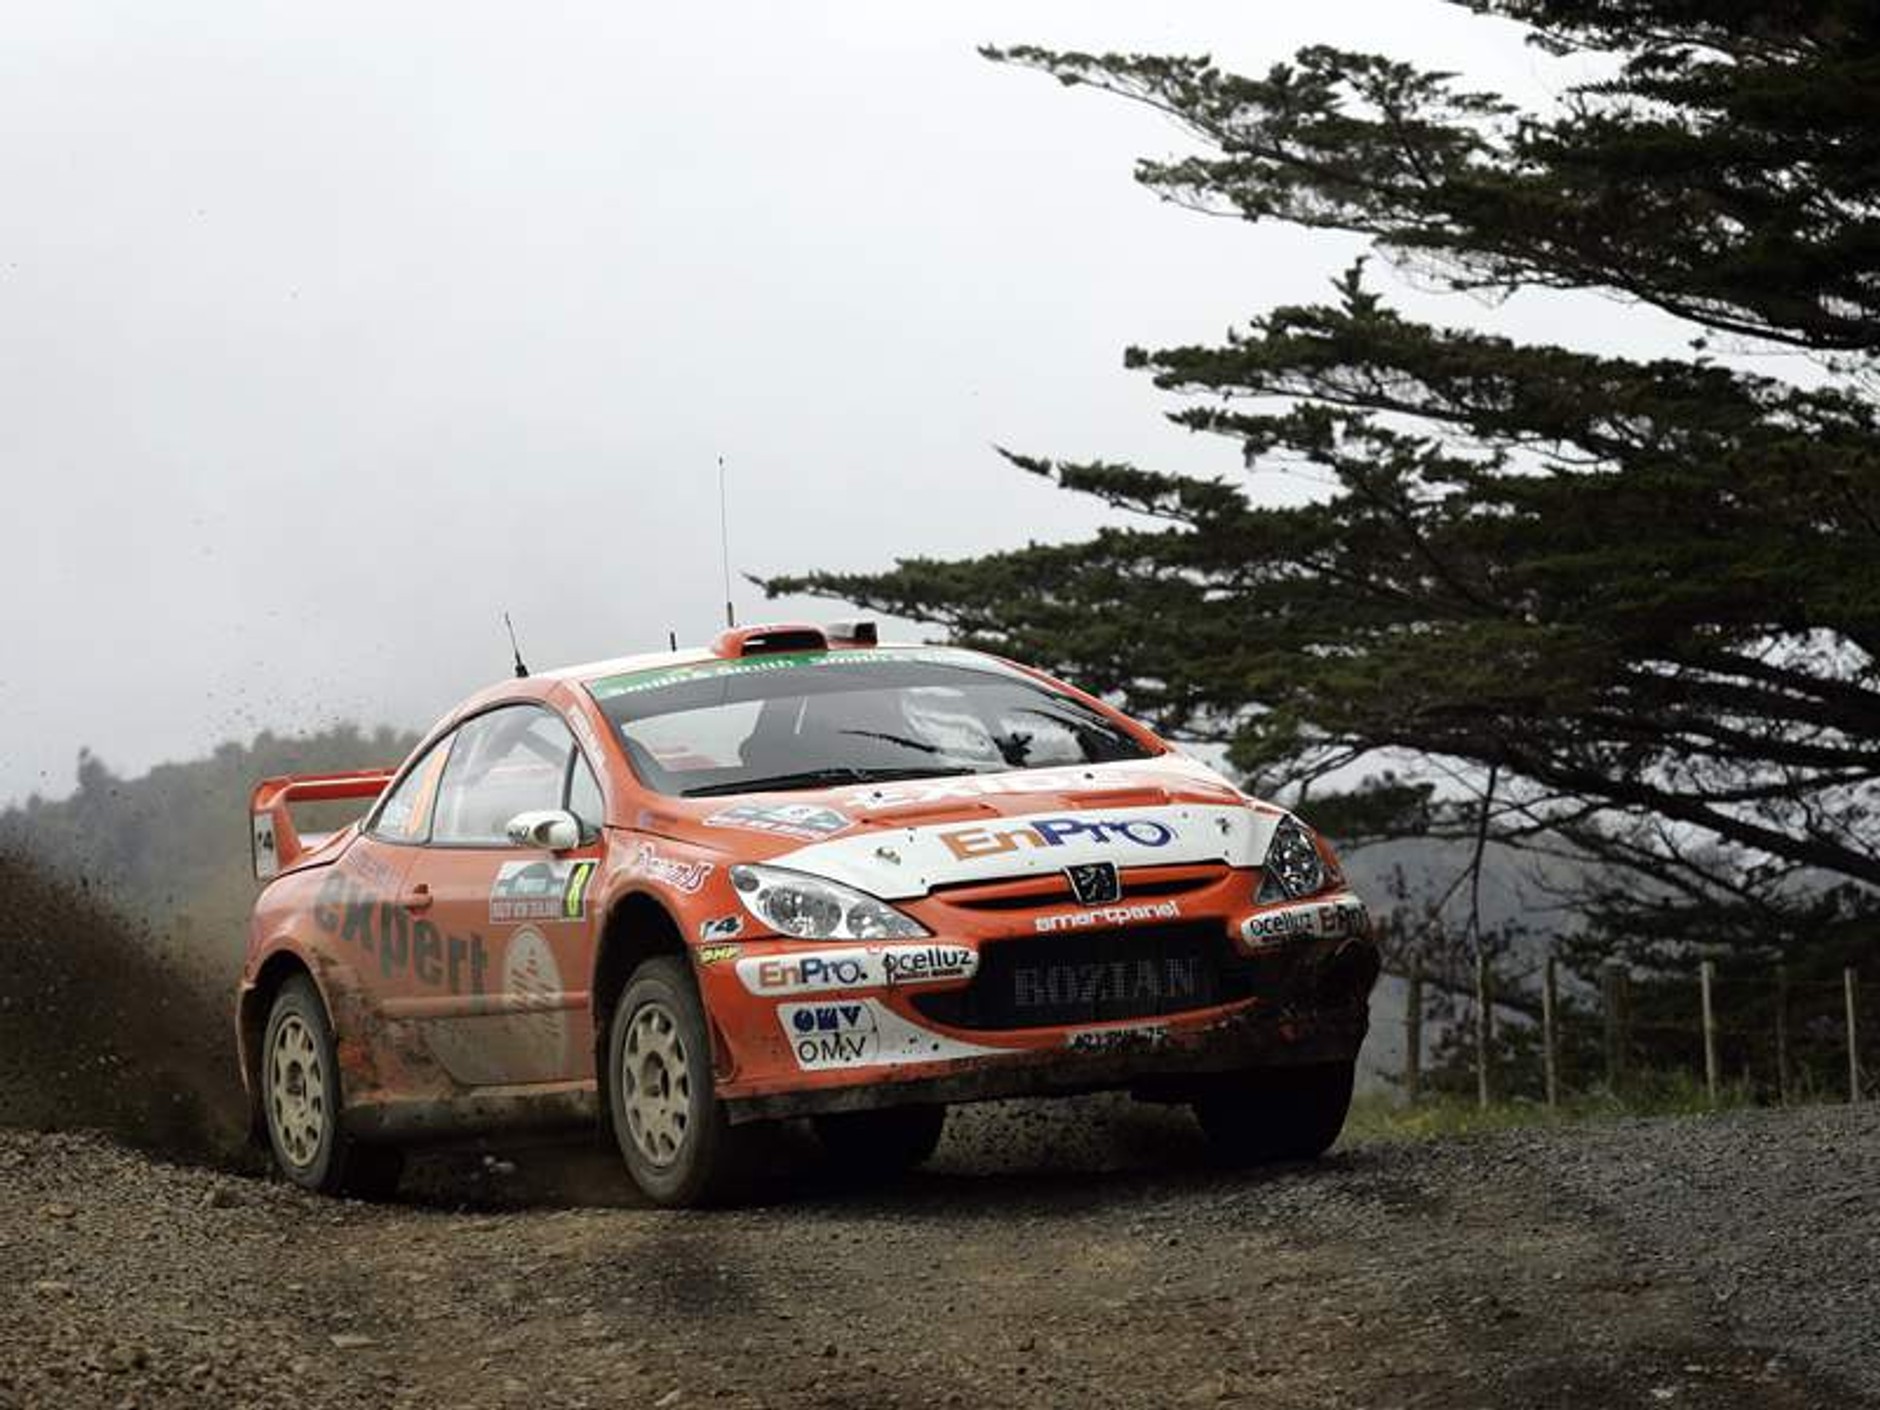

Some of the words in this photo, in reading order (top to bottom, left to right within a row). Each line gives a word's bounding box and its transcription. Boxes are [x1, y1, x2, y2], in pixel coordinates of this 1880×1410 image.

[938, 818, 1173, 860] EnPro
[1035, 901, 1182, 932] smartpanel
[315, 868, 490, 1010] expert
[759, 957, 861, 987] EnPro
